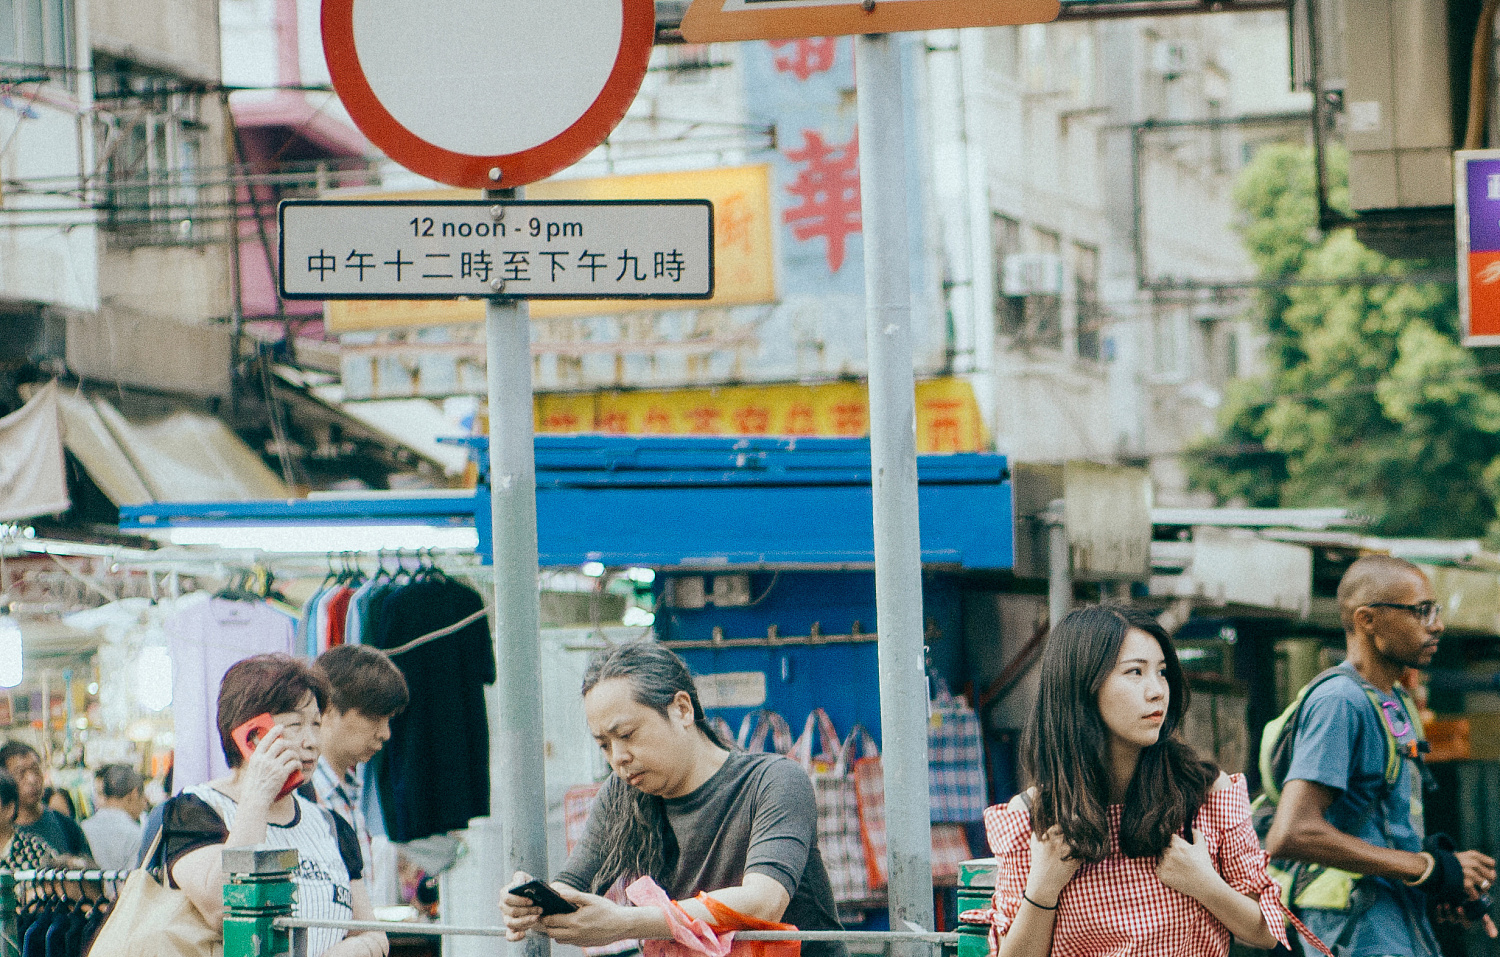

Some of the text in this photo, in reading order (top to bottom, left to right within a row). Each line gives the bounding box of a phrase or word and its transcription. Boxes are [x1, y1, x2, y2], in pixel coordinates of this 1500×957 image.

[410, 217, 435, 237] 12
[442, 217, 506, 238] noon
[528, 217, 542, 238] 9
[546, 222, 583, 242] pm
[307, 248, 686, 283] 中午十二時至下午九時
